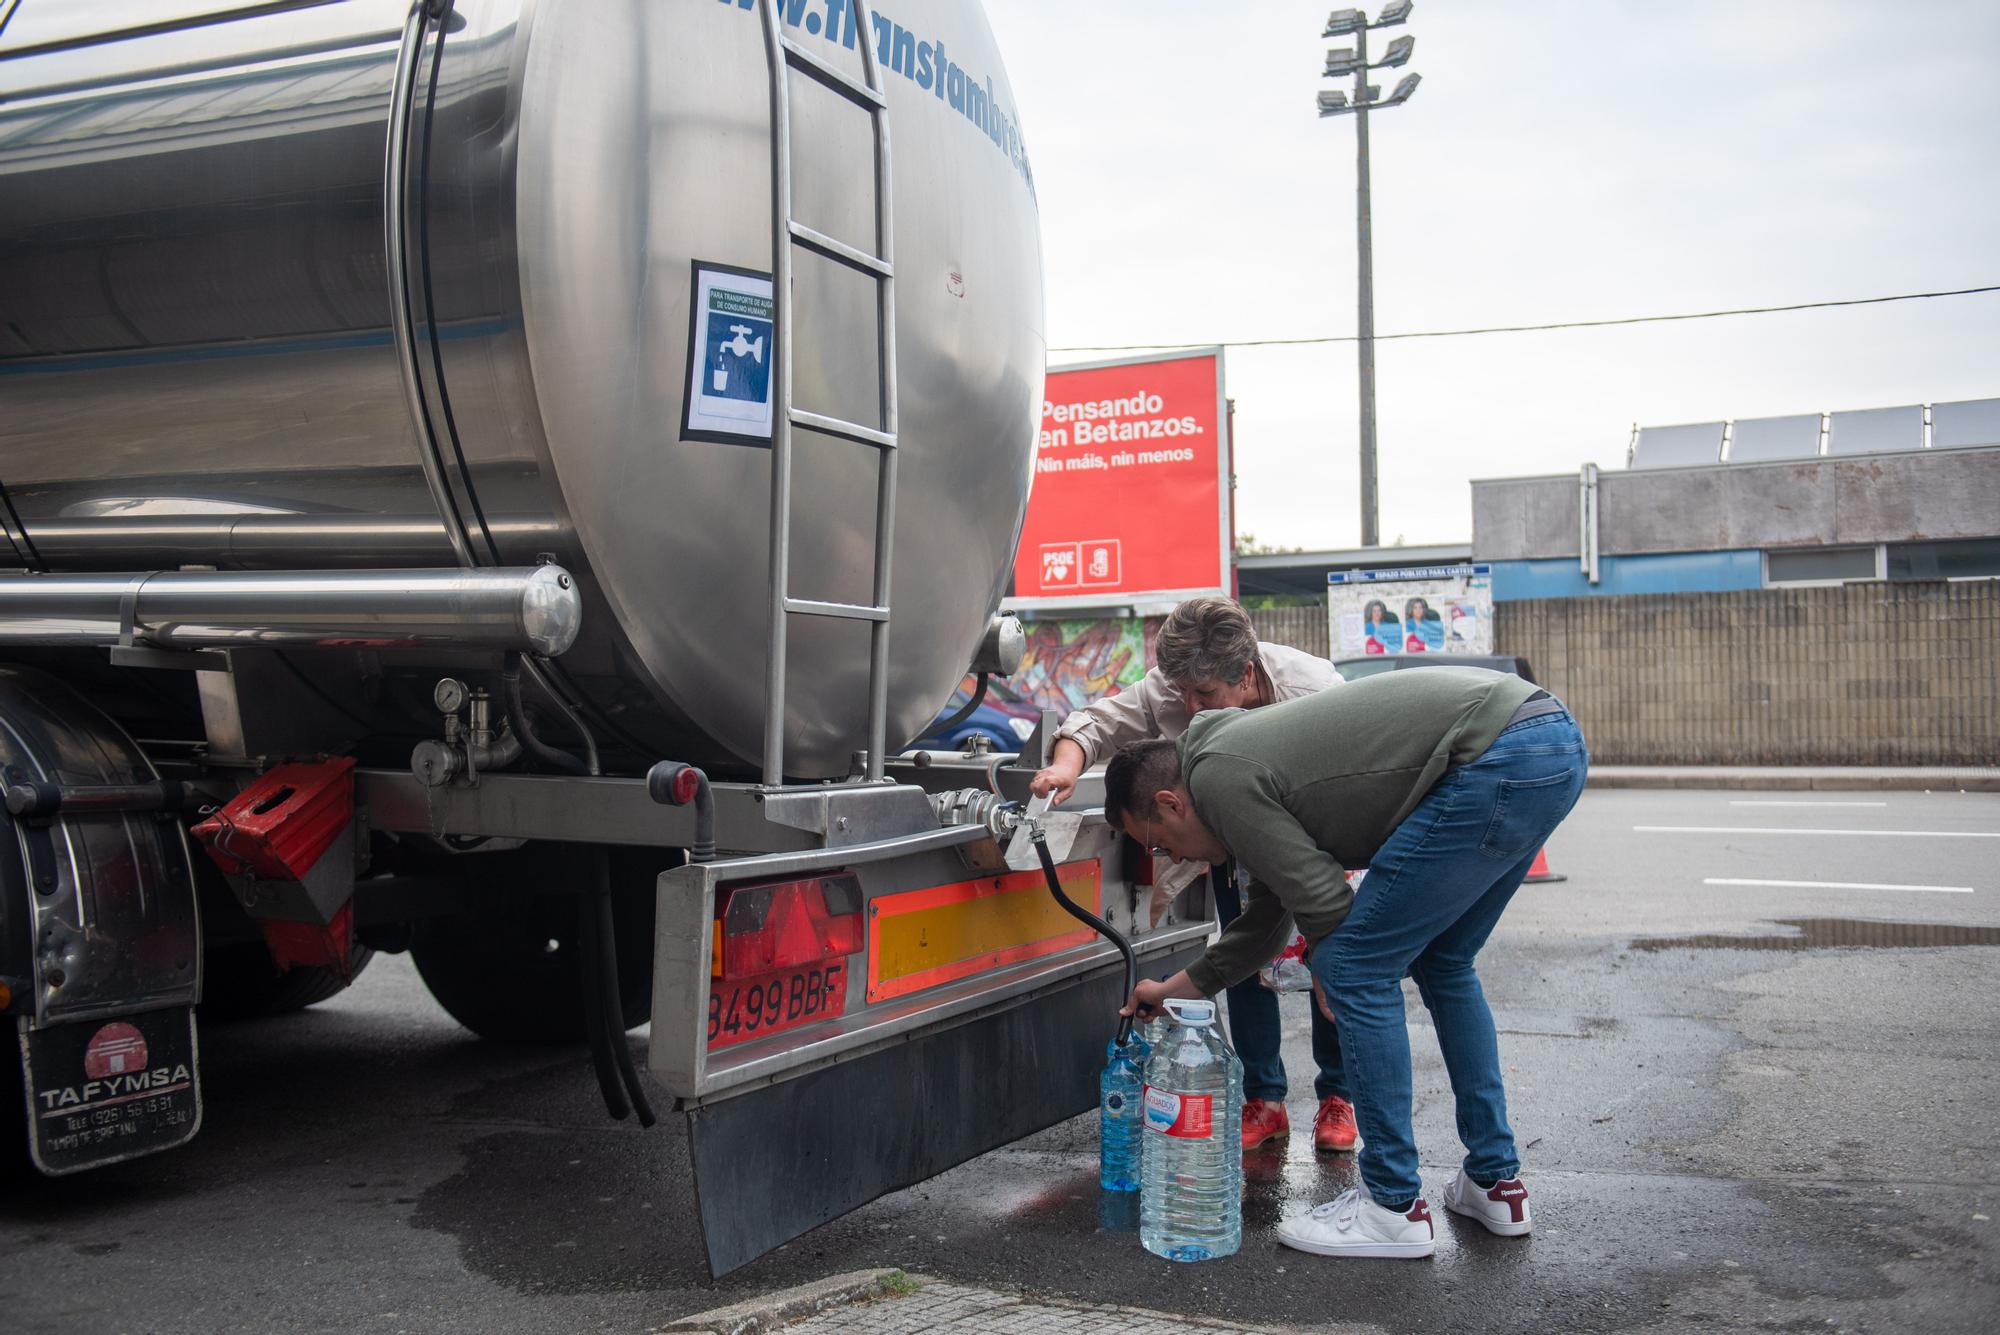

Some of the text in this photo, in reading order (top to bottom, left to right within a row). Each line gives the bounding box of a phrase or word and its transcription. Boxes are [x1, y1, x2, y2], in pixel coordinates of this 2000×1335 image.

[710, 290, 724, 300] PARA
[724, 293, 754, 306] TRANSPORTE
[717, 301, 767, 317] DE CONSUMO HUMANO
[1042, 390, 1164, 423] Pensando
[1039, 416, 1204, 449] en Betanzos.
[1037, 447, 1194, 474] Nin máis, nin menos
[1043, 550, 1075, 566] PSOE
[1375, 570, 1399, 579] ESPAZO
[1428, 568, 1446, 576] PARA
[787, 966, 841, 1021] BBF
[39, 1064, 191, 1109] TAFYMSA
